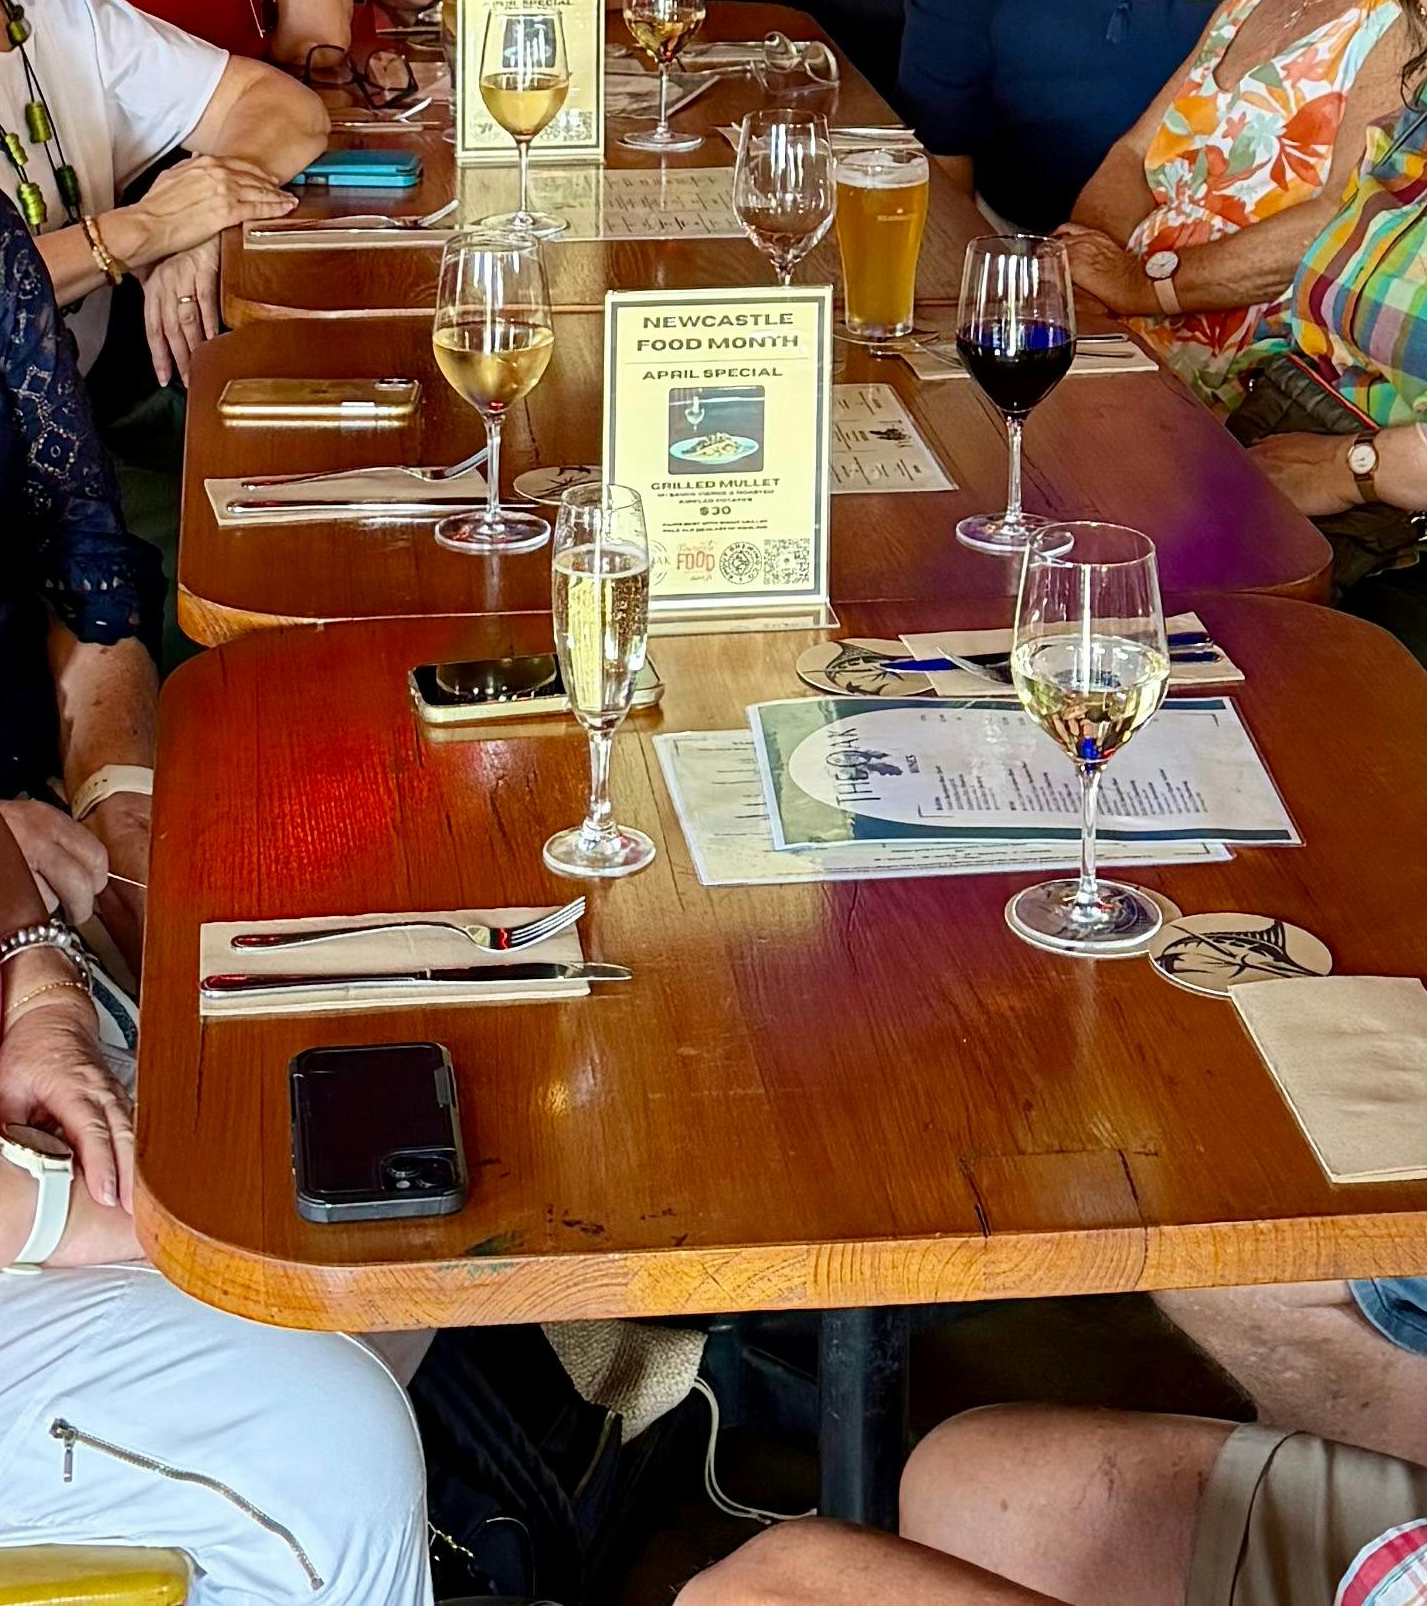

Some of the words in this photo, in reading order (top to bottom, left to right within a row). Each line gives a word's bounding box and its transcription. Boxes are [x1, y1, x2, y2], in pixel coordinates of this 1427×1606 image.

[643, 313, 794, 329] NEWCASTLE
[637, 337, 702, 351] FOOD
[707, 335, 799, 349] MONTH
[642, 369, 700, 380] APRIL
[703, 367, 783, 379] SPECIAL
[651, 480, 716, 491] GRILLED
[719, 478, 780, 489] MULLET
[699, 505, 732, 516] $30
[676, 550, 716, 572] FOOD
[835, 768, 882, 806] THE
